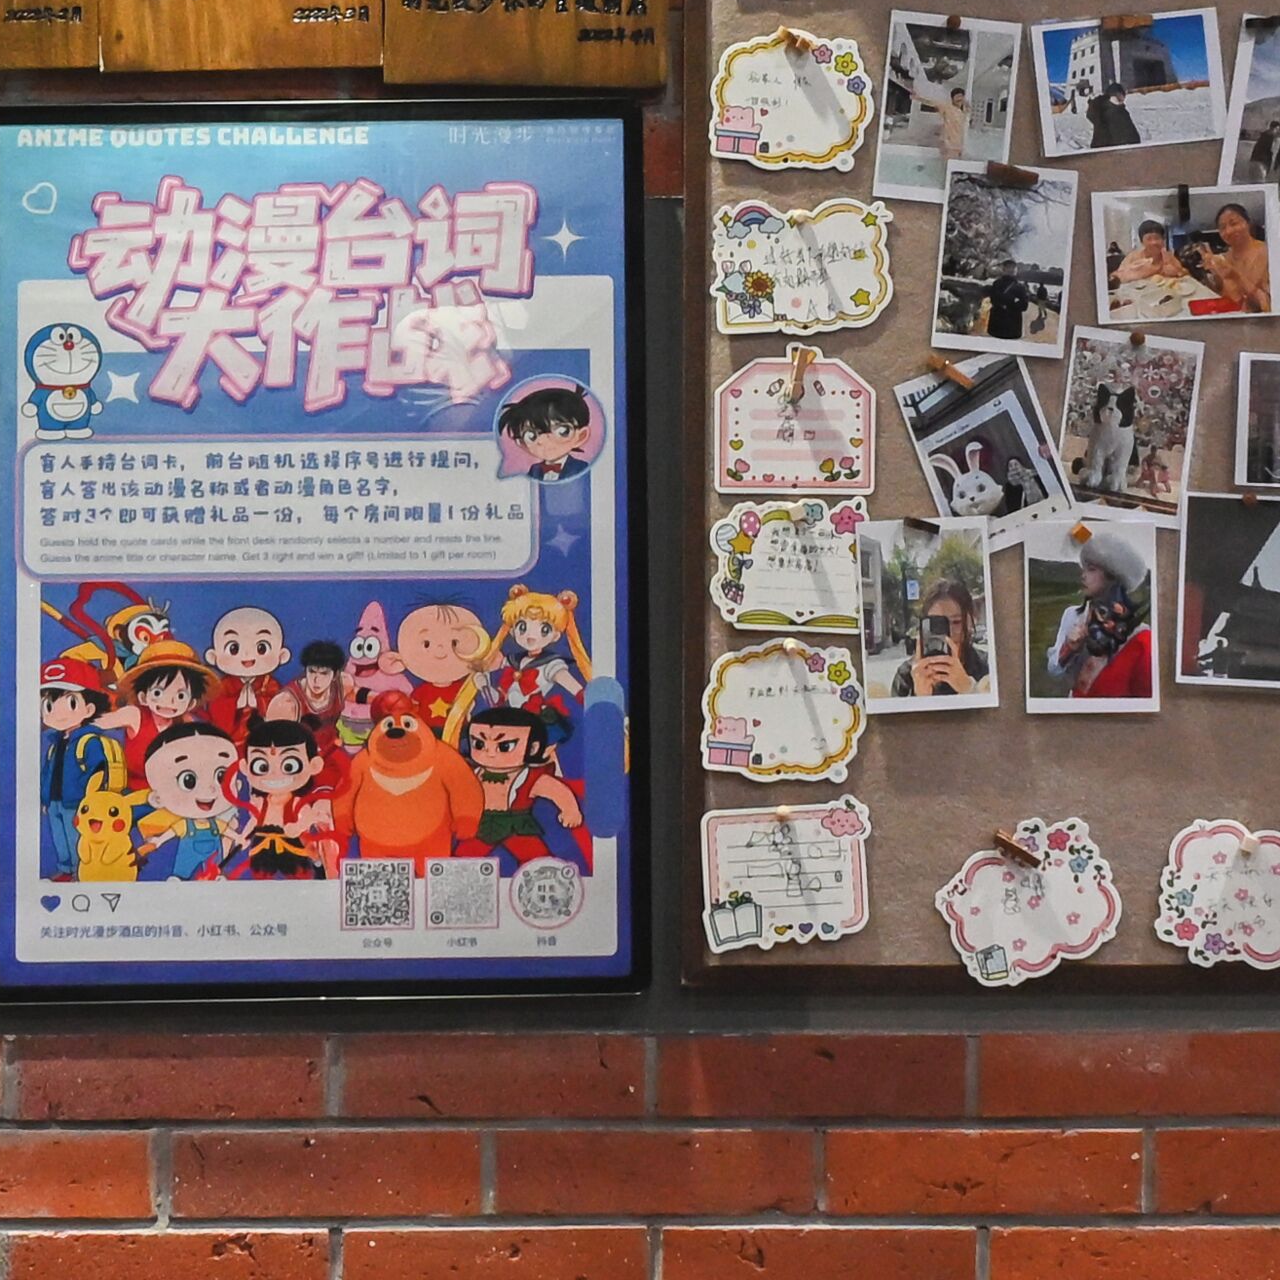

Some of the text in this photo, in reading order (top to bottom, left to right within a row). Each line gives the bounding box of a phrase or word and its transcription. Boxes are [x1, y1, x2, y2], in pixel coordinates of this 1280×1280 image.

[17, 126, 370, 149] ANIME QUOTES CHALLENGE
[448, 125, 533, 146] 时光漫步
[70, 177, 538, 335] 动漫台词
[149, 282, 512, 414] 大作战
